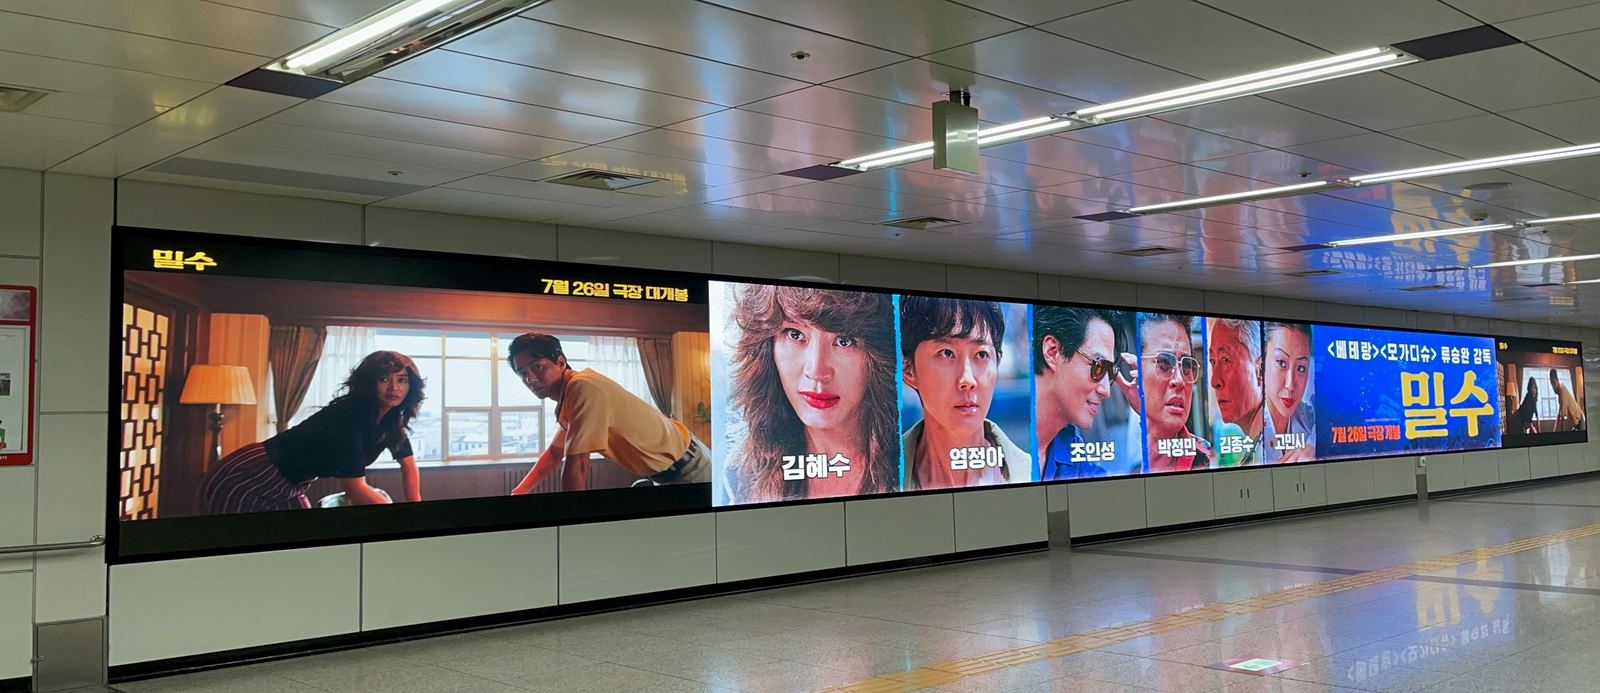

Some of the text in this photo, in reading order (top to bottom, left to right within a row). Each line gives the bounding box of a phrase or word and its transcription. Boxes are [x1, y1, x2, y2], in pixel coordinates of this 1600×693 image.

[153, 249, 218, 271] 밀수
[541, 278, 689, 302] 7월 26일 극장 대개봉
[1440, 346, 1470, 365] 류승완
[1473, 348, 1492, 366] 감독
[1400, 369, 1495, 440] 밀수
[1219, 435, 1254, 455] 김종수
[1274, 432, 1306, 450] 고민시
[1347, 426, 1367, 443] 26일
[1070, 441, 1115, 462] 조인성
[1158, 436, 1197, 457] 박정민
[781, 452, 850, 481] 김혜수
[949, 446, 1005, 470] 염정아
